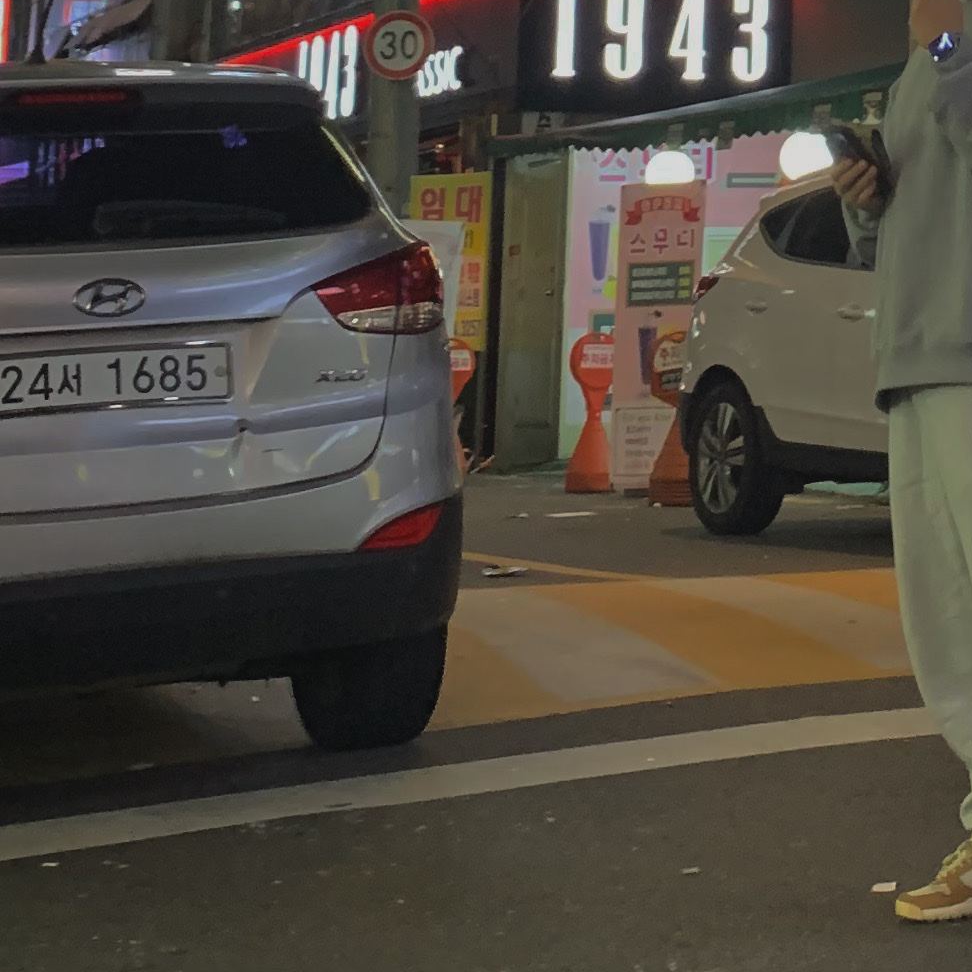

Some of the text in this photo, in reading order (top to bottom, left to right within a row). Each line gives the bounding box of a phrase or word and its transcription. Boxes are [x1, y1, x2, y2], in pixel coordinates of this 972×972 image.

[379, 30, 418, 60] 30
[420, 184, 483, 225] 임대
[629, 228, 695, 256] 스무디
[1, 354, 207, 406] 24서 1685
